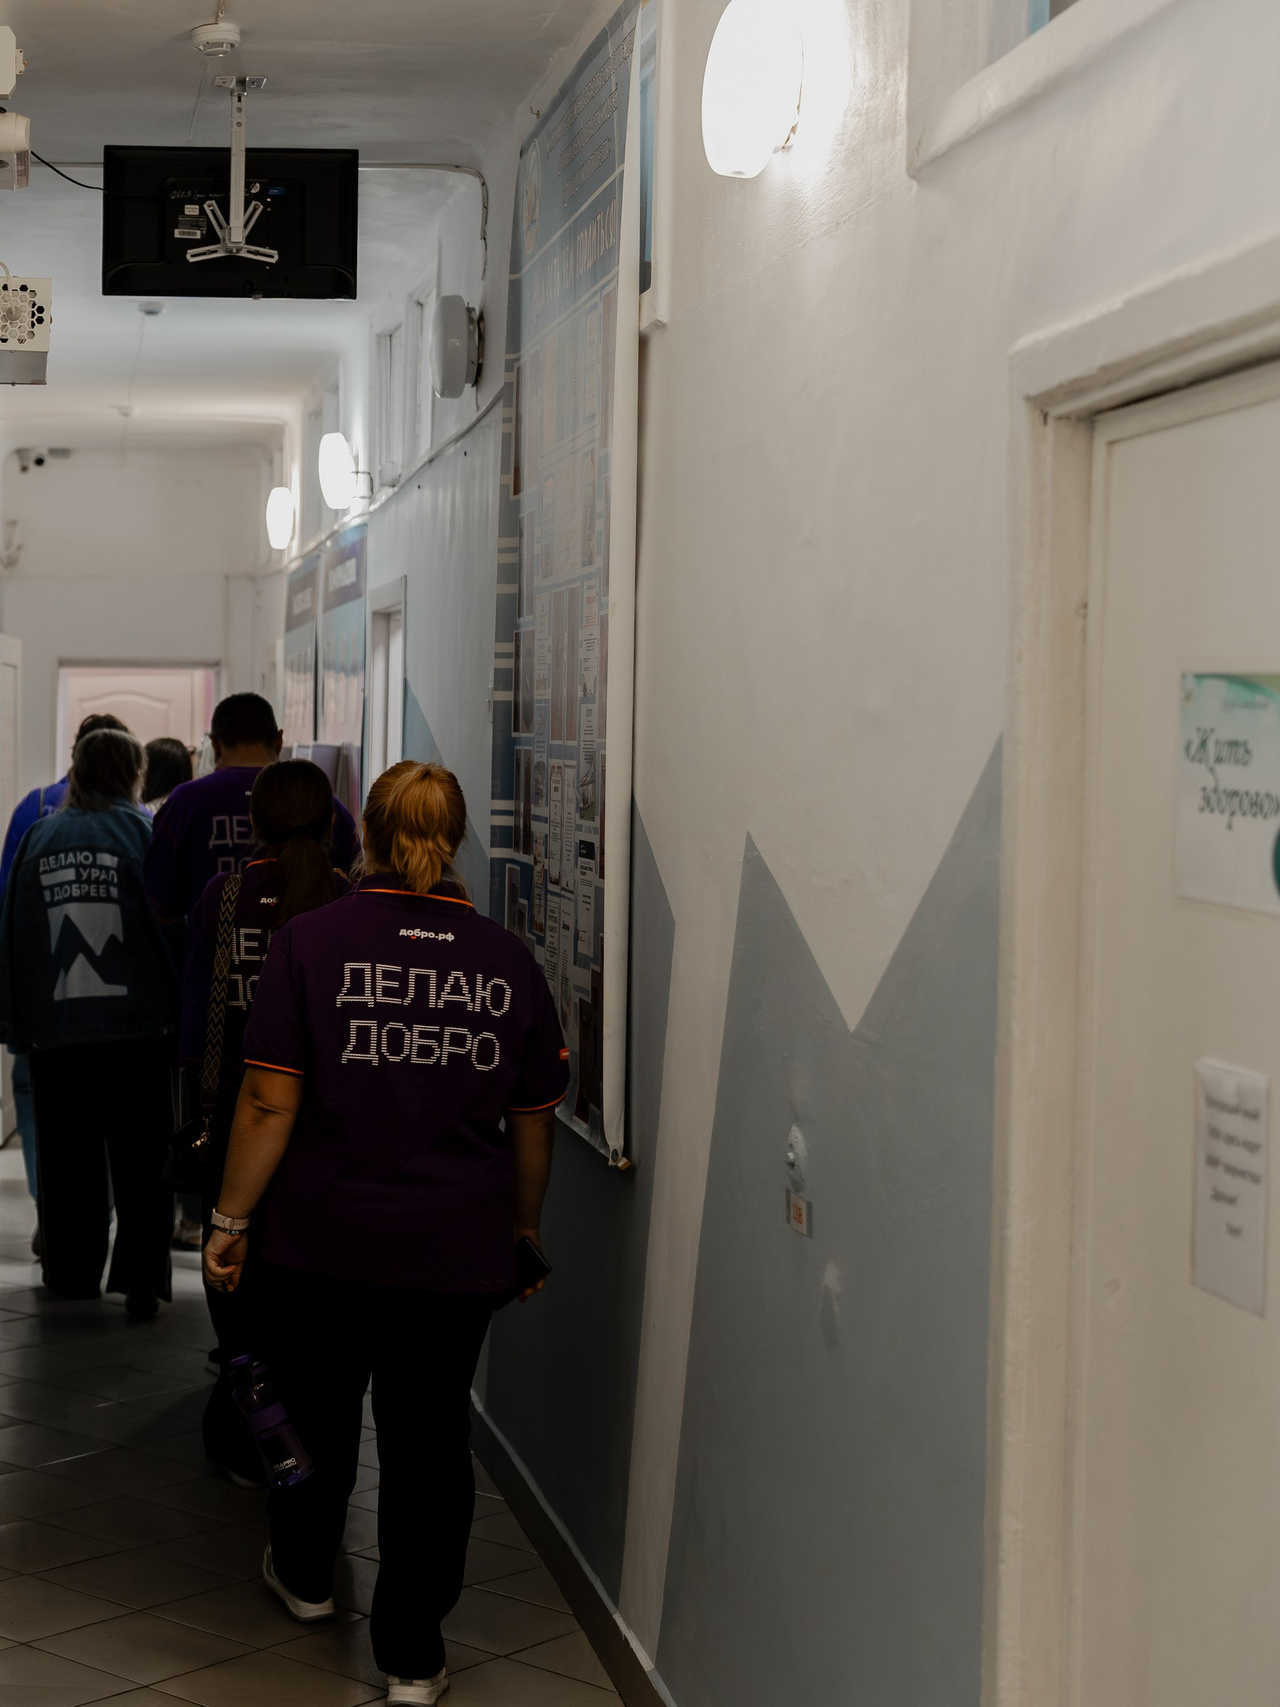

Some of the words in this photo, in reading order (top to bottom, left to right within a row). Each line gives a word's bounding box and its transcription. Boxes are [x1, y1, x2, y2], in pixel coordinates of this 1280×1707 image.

[39, 851, 93, 873] ДЕЛАЮ
[79, 867, 118, 883] УРАЛ
[53, 884, 107, 902] ДОБРЕЕ
[399, 928, 455, 942] добро.рф
[336, 962, 513, 1018] ДЕЛАЮ
[341, 1019, 500, 1072] ДОБРО
